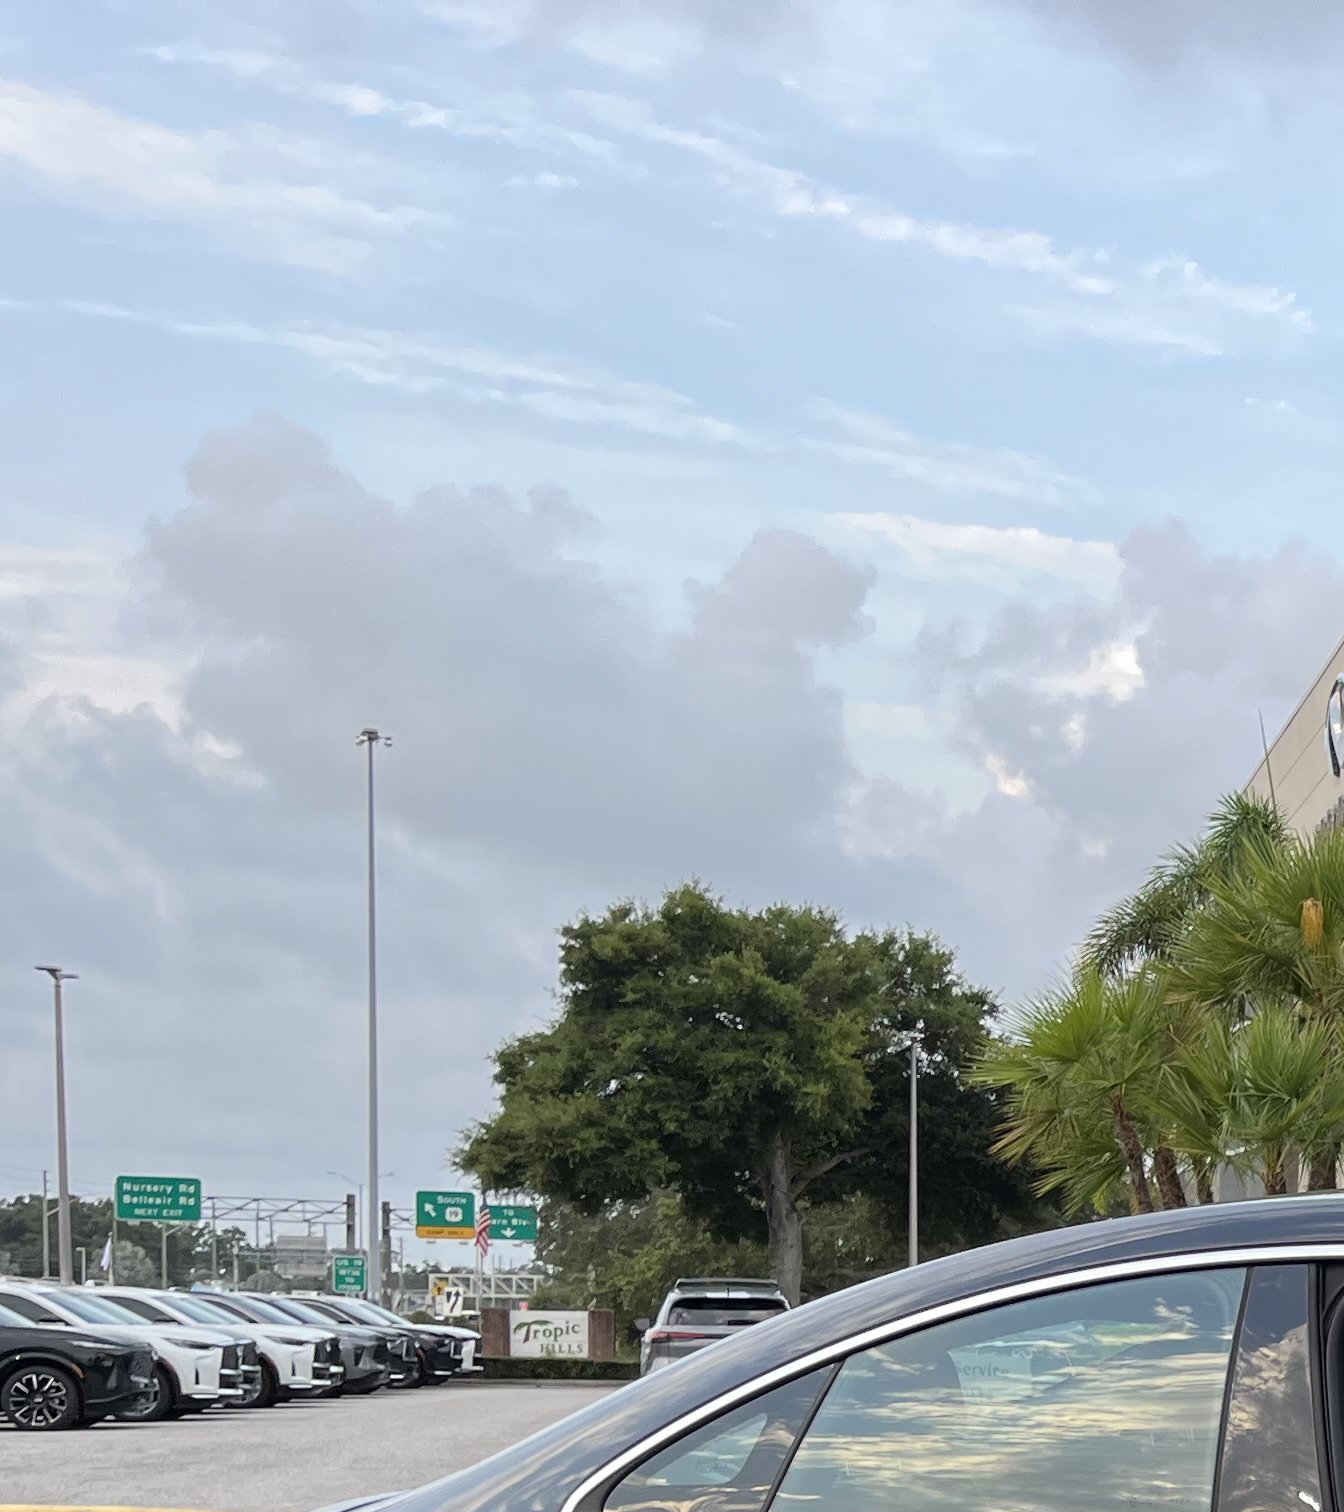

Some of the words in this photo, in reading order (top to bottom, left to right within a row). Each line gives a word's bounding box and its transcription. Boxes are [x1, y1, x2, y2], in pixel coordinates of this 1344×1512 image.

[123, 1182, 173, 1195] Nursery
[179, 1184, 195, 1194] Rd
[179, 1196, 195, 1206] Rd
[513, 1319, 581, 1344] Tropic
[540, 1343, 583, 1353] HILLS
